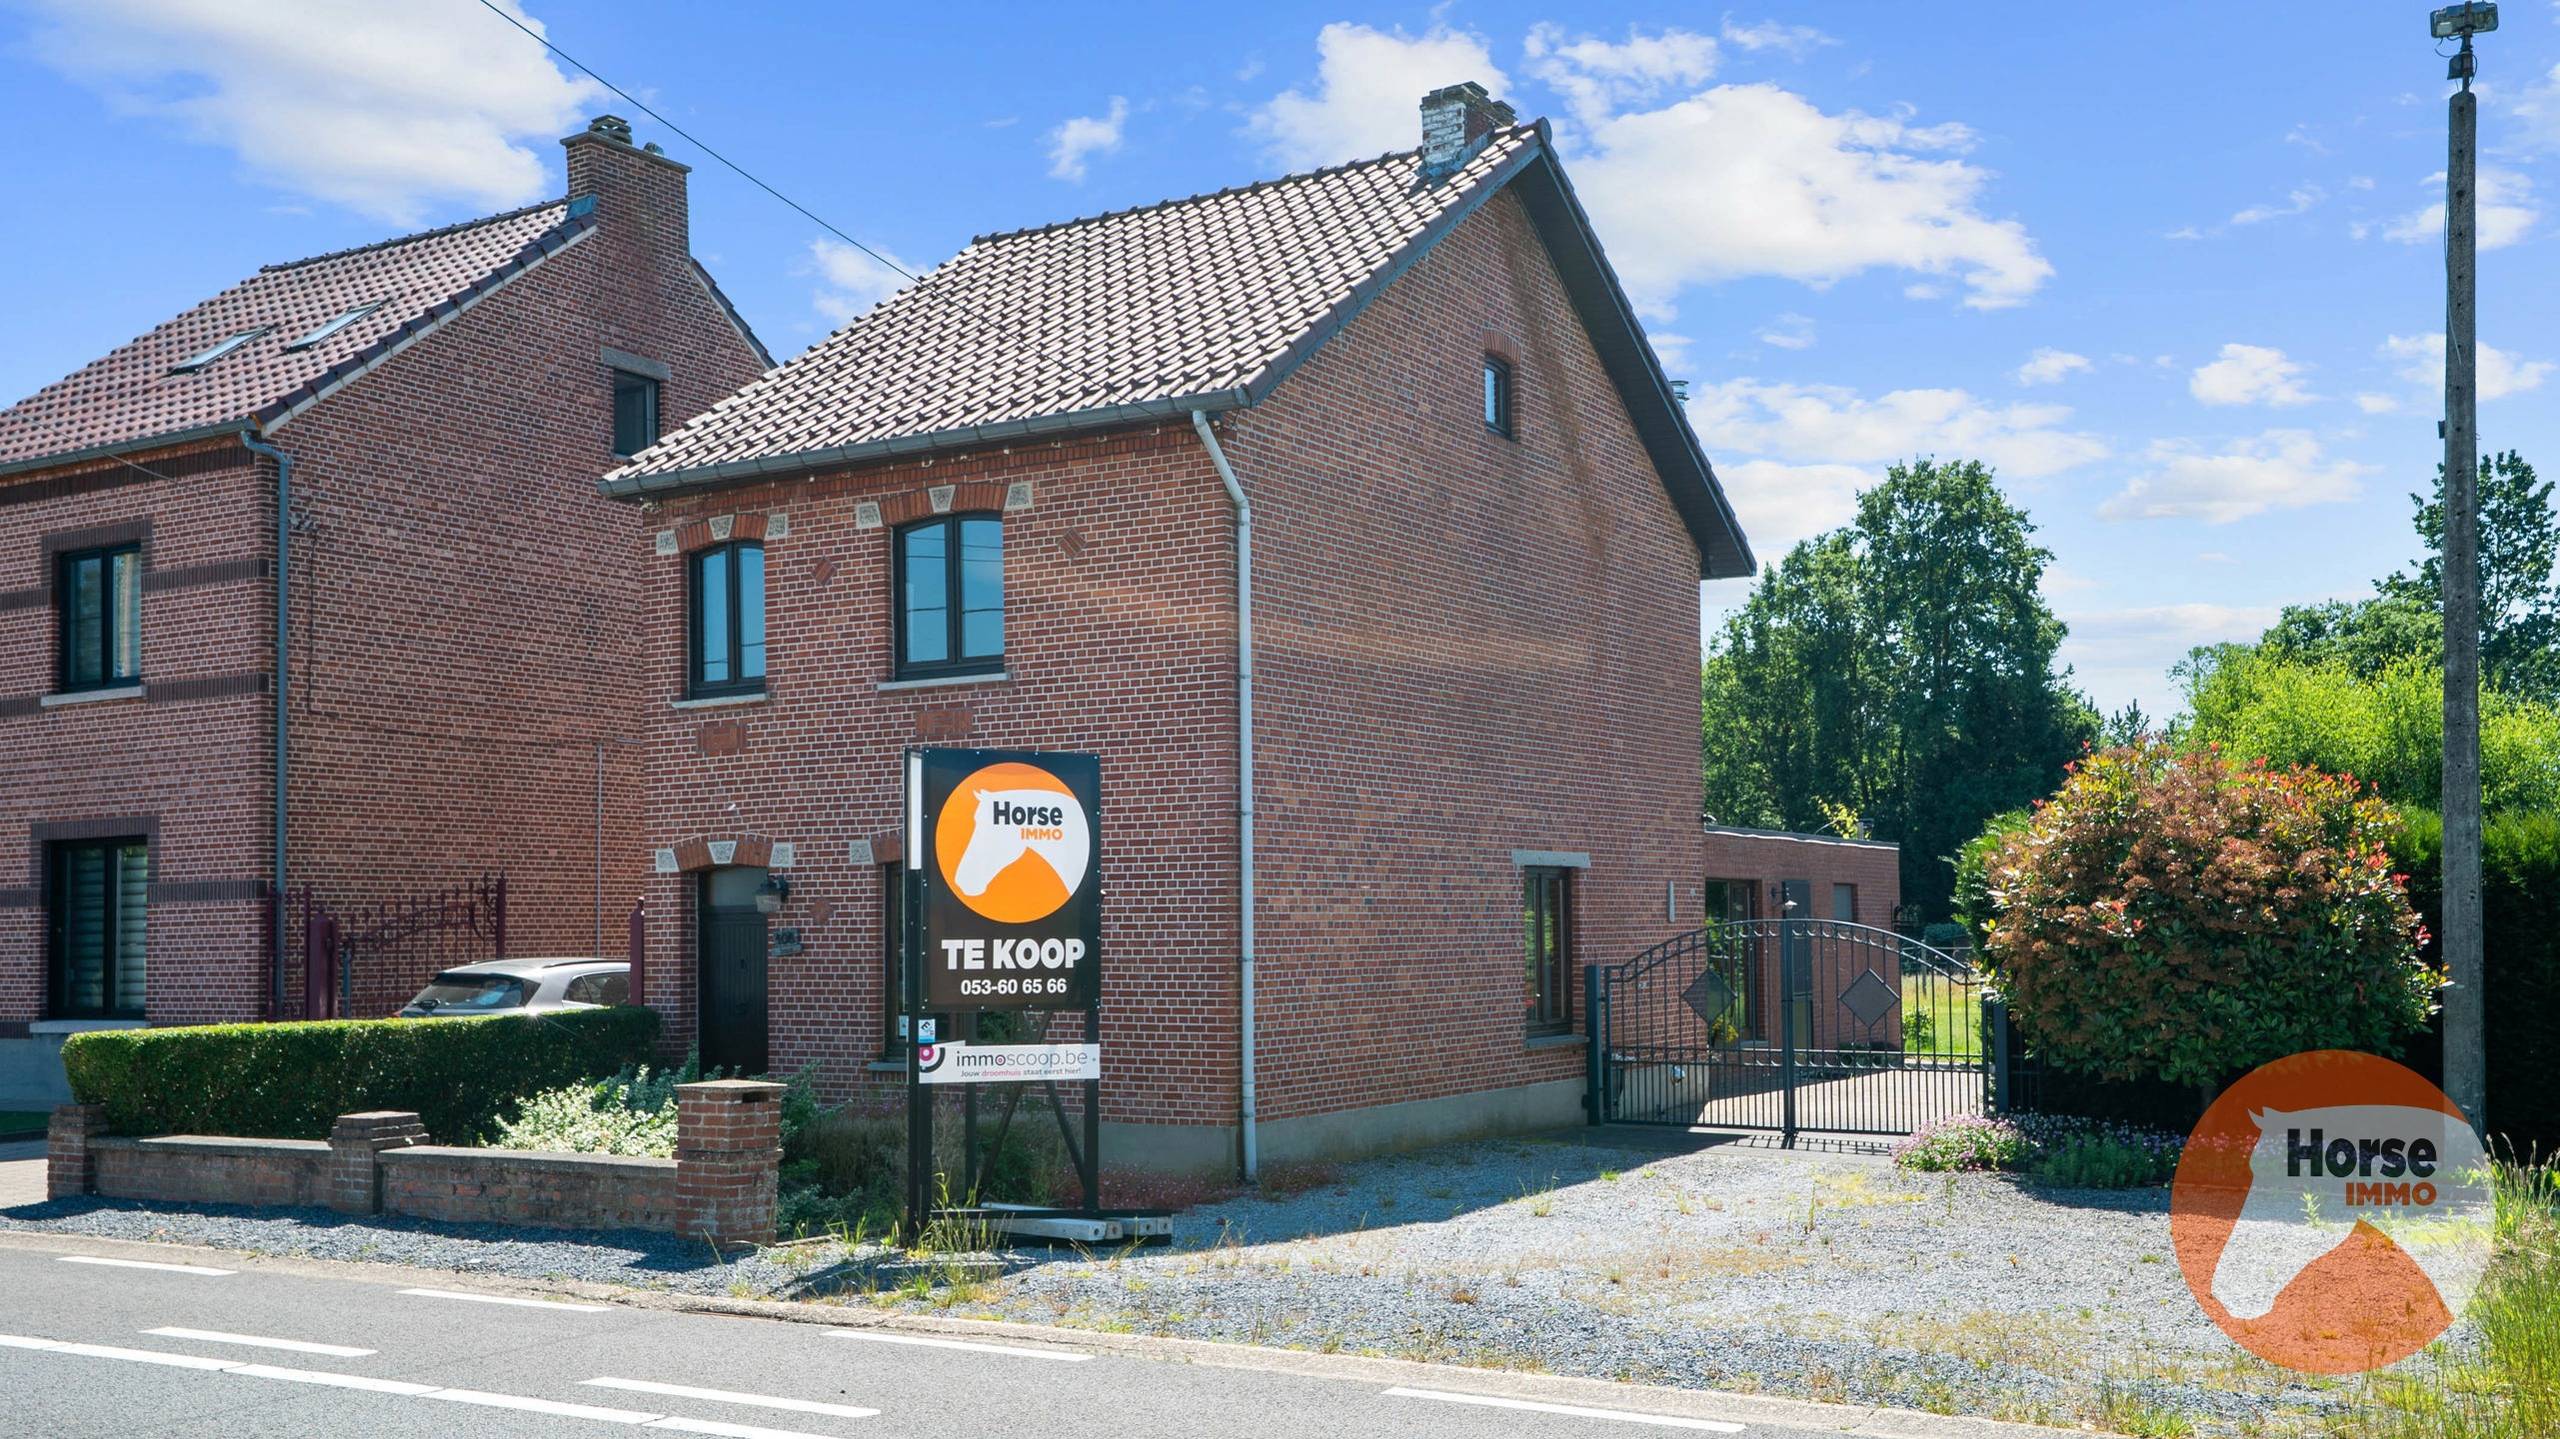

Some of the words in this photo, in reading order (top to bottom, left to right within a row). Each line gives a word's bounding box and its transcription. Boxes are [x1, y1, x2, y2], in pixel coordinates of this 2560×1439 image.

[993, 801, 1063, 825] Horse
[1021, 828, 1063, 841] IMMO
[941, 939, 985, 970] TE
[993, 938, 1086, 970] KOOP
[961, 979, 1018, 995] 053-60
[1022, 979, 1043, 994] 65
[1046, 978, 1067, 994] 66
[956, 1050, 1088, 1069] immoscoop.be
